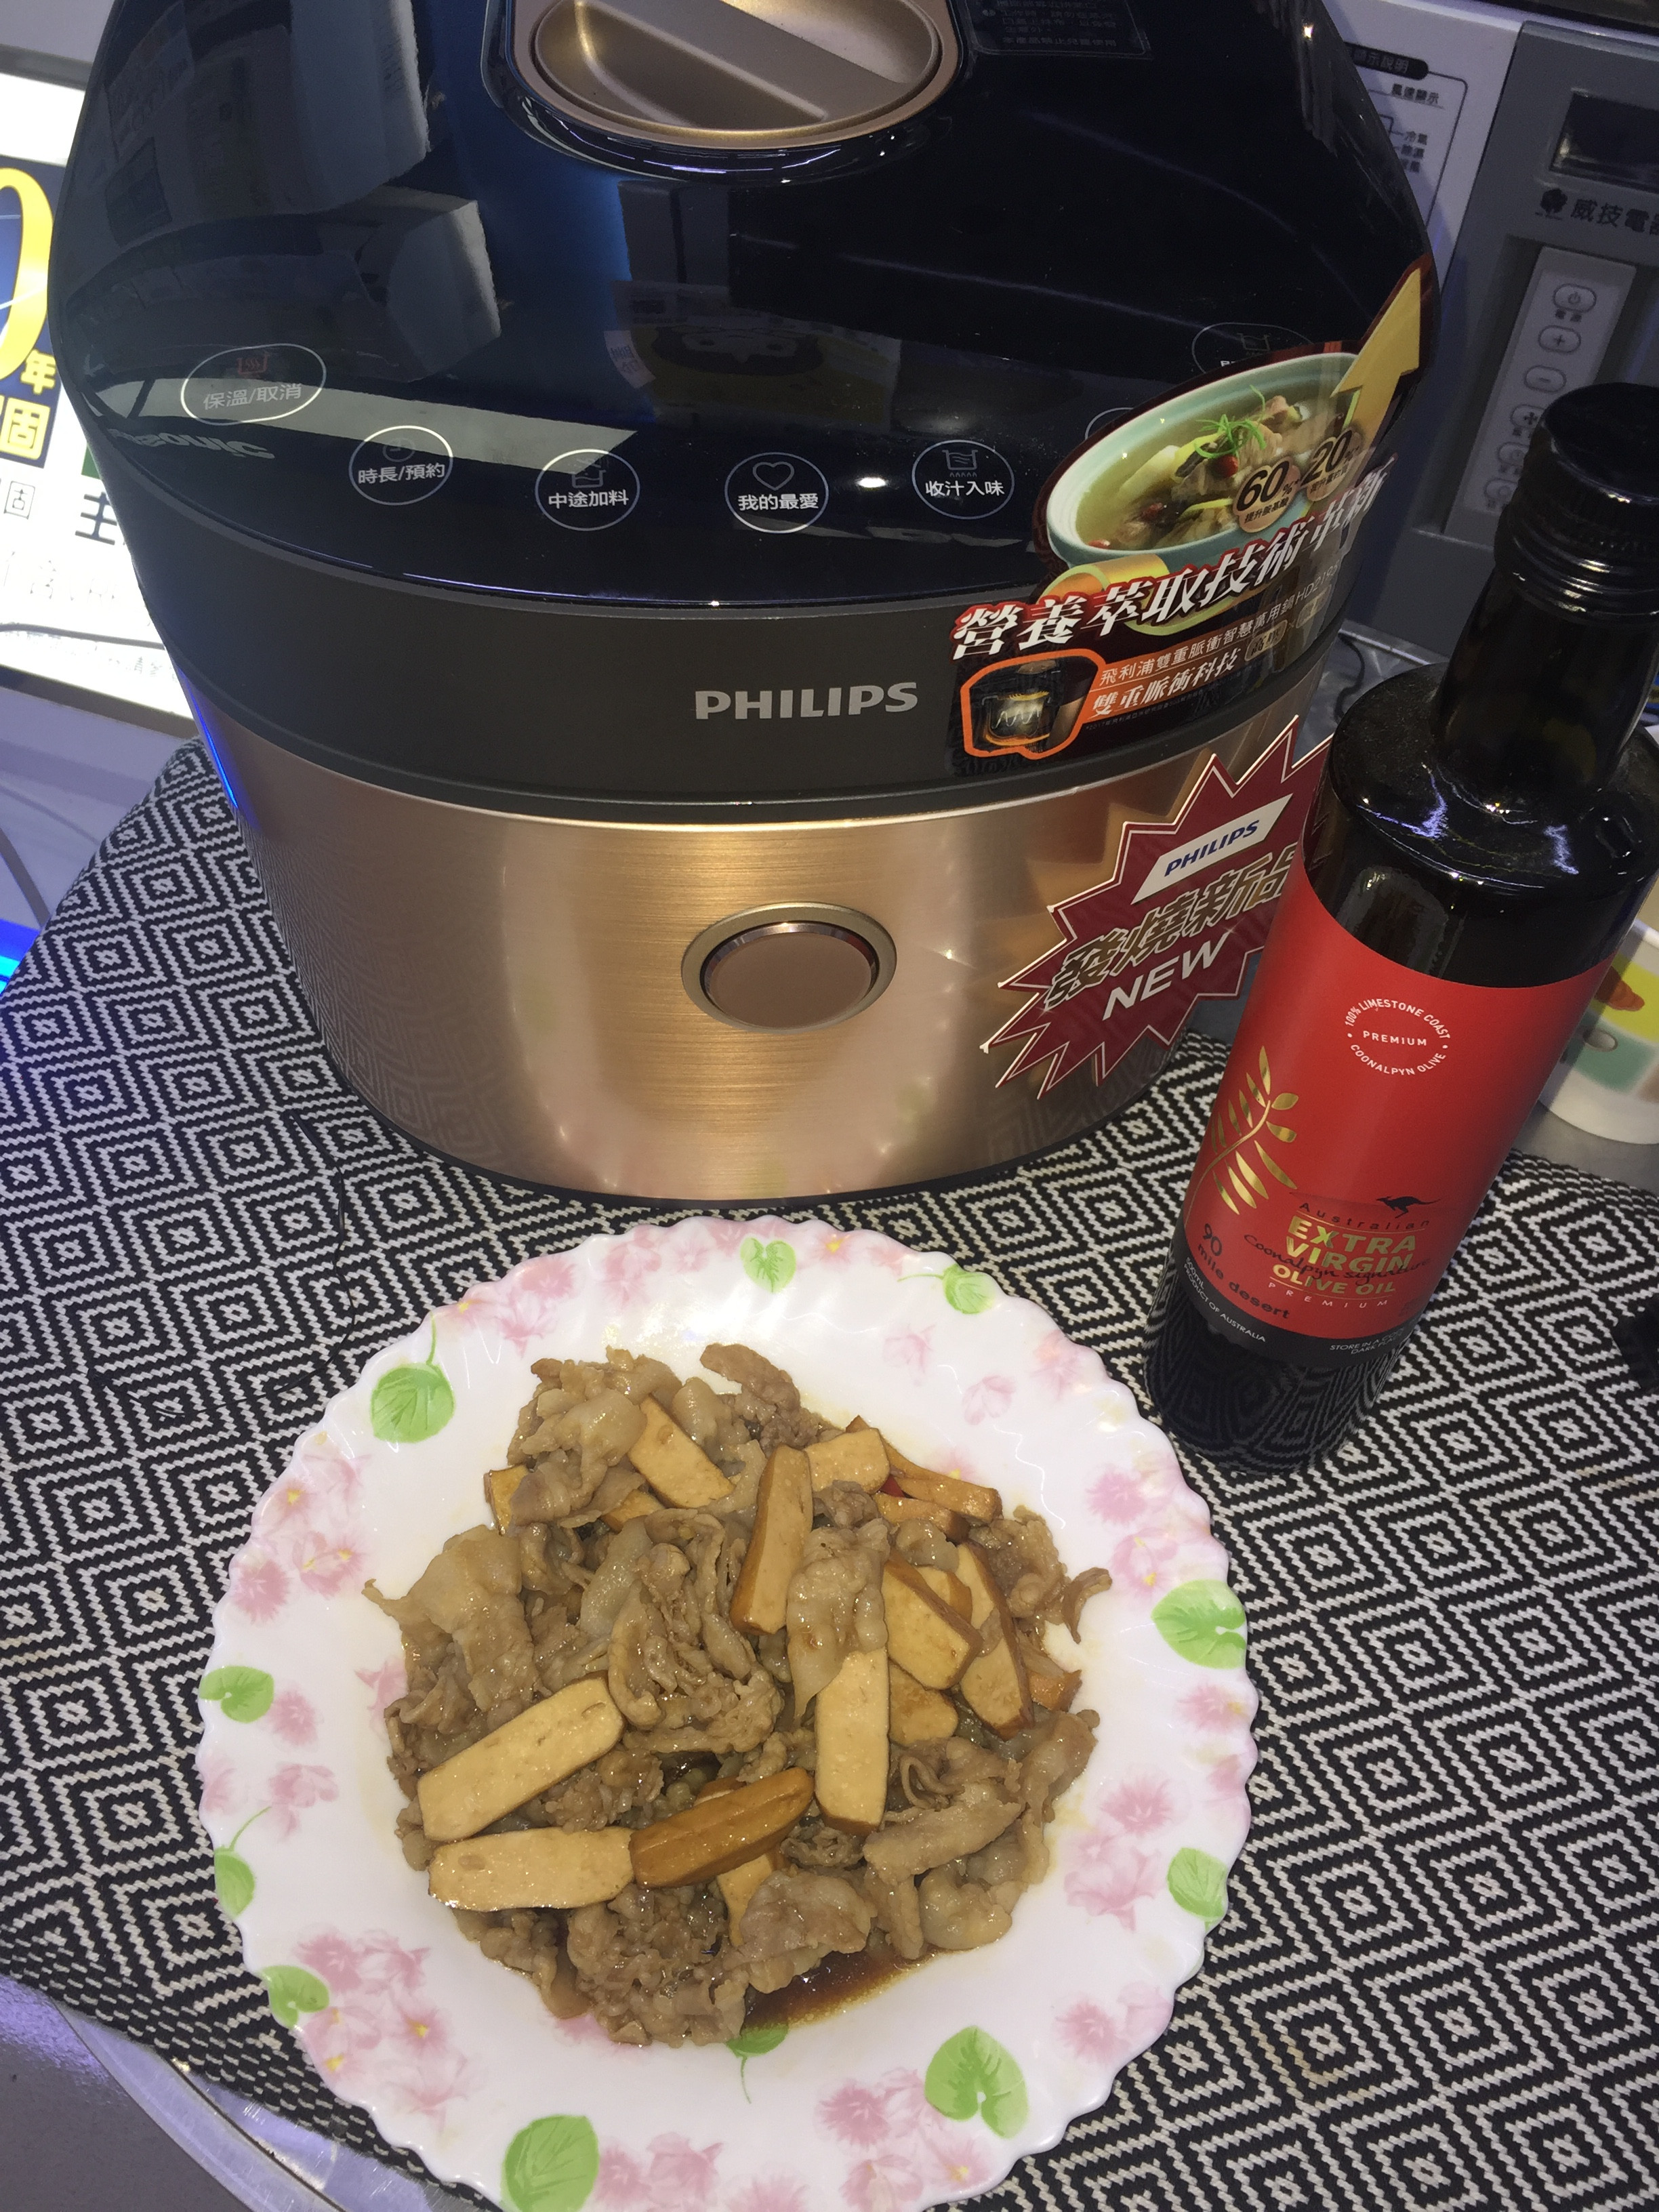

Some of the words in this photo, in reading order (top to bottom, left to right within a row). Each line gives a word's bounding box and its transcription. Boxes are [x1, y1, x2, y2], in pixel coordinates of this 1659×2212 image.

[203, 383, 302, 410] 保溫/取消
[358, 462, 445, 485] 時長/預約
[924, 480, 1005, 497] 收汁入味
[548, 489, 630, 510] 中途加料
[738, 493, 819, 512] 我的最愛
[1087, 647, 1242, 720] 雙重脈衝科技
[695, 682, 918, 719] PHILIPS
[1164, 819, 1260, 878] PHILIPS
[1103, 931, 1231, 1021] NEW
[1345, 1006, 1361, 1027] 100%
[1358, 998, 1425, 1017] LIMESTONE
[1423, 1015, 1451, 1039] COAST
[1363, 1030, 1427, 1046] PREMIUM
[1351, 1044, 1415, 1076] COONALPYN
[1416, 1052, 1446, 1073] OLIVE
[1299, 1202, 1430, 1230] Australian
[1203, 1223, 1222, 1256] 90
[1288, 1216, 1416, 1254] EXTRA
[1244, 1234, 1340, 1283] Coonalpyn
[1286, 1236, 1413, 1273] VIRGIN
[1198, 1244, 1224, 1279] mile
[1229, 1282, 1290, 1319] desert
[1268, 1282, 1388, 1309] PREMIUM
[1272, 1264, 1349, 1294] OLIVE
[1355, 1282, 1396, 1295] OIL
[1184, 1263, 1209, 1302] PRODUCT
[1208, 1300, 1221, 1313] OF
[1220, 1313, 1266, 1343] AUSTRALIA
[1330, 1343, 1360, 1351] STORE
